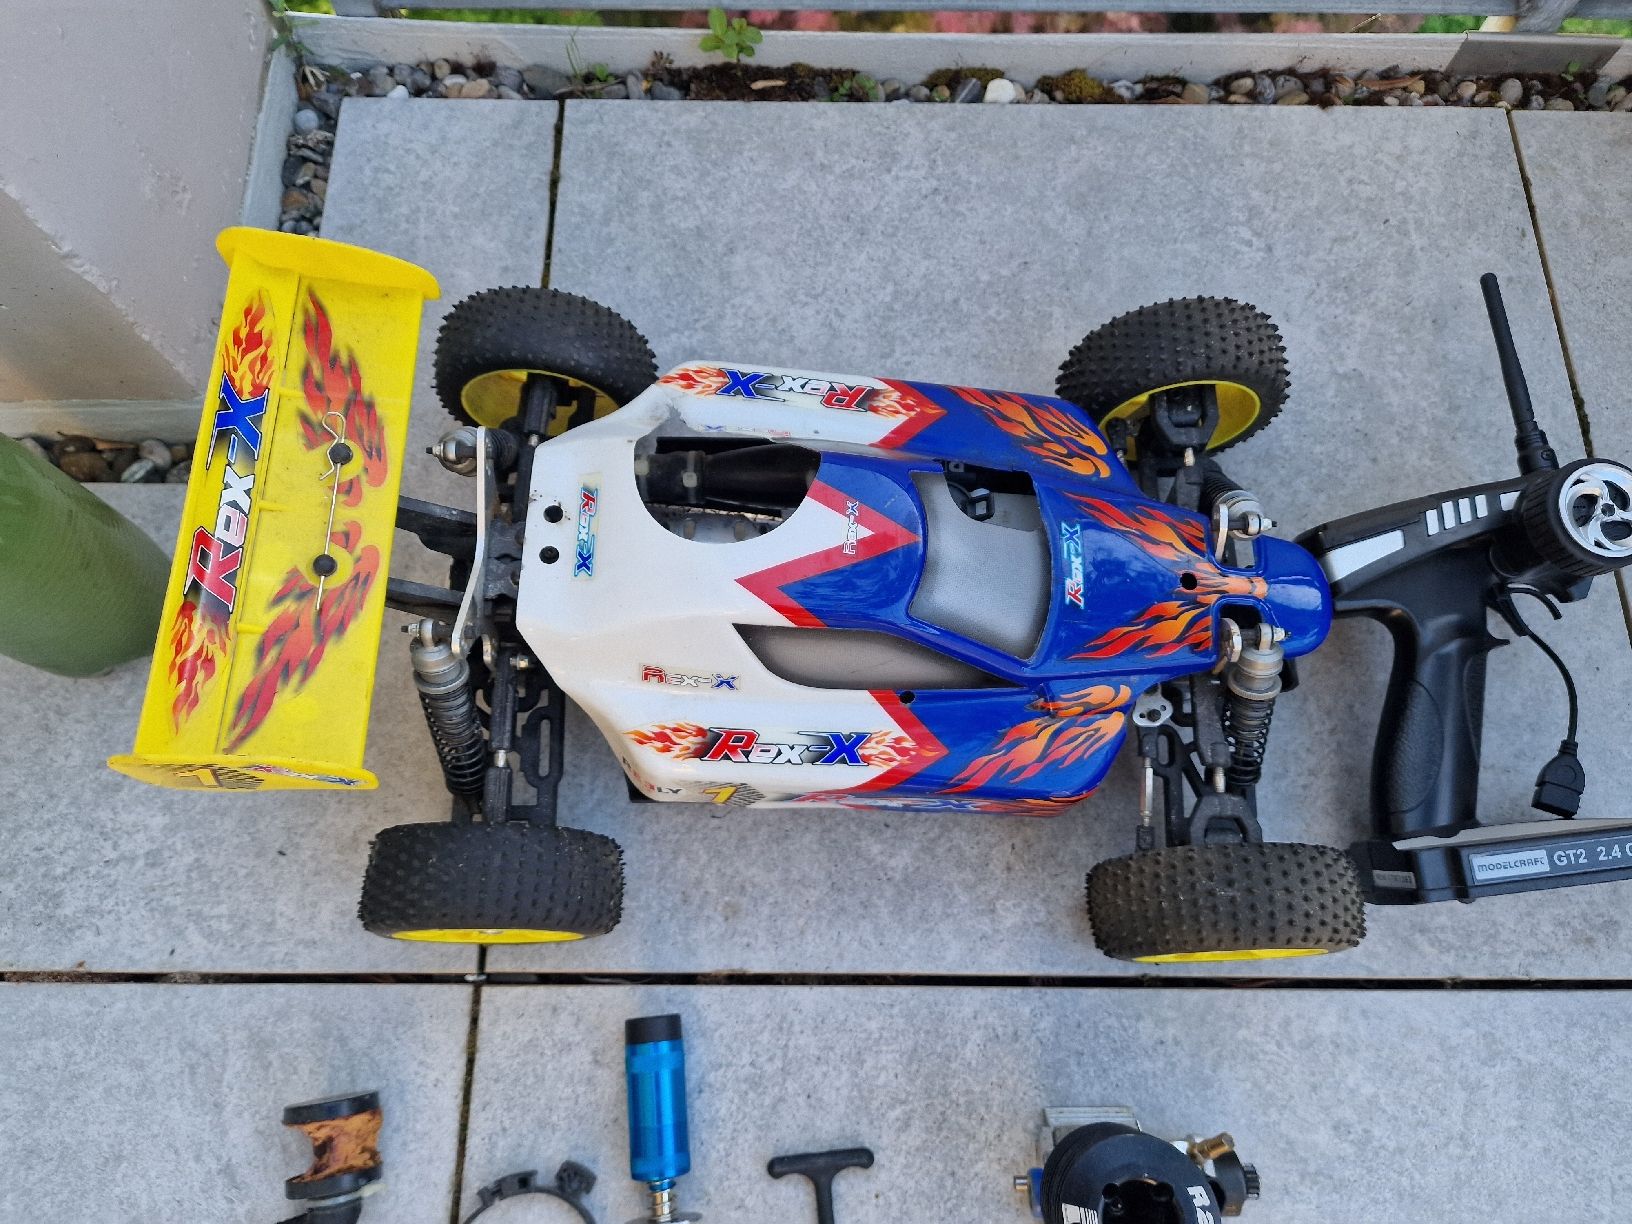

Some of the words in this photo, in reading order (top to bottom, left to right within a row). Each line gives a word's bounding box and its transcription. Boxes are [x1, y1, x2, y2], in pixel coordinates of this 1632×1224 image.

[713, 368, 874, 413] Rex-X
[183, 371, 271, 613] Rex-X
[700, 727, 873, 766] Rex-X
[1477, 857, 1546, 873] MODELCRAFT
[1553, 848, 1588, 866] GT2
[1596, 844, 1622, 861] 2.4
